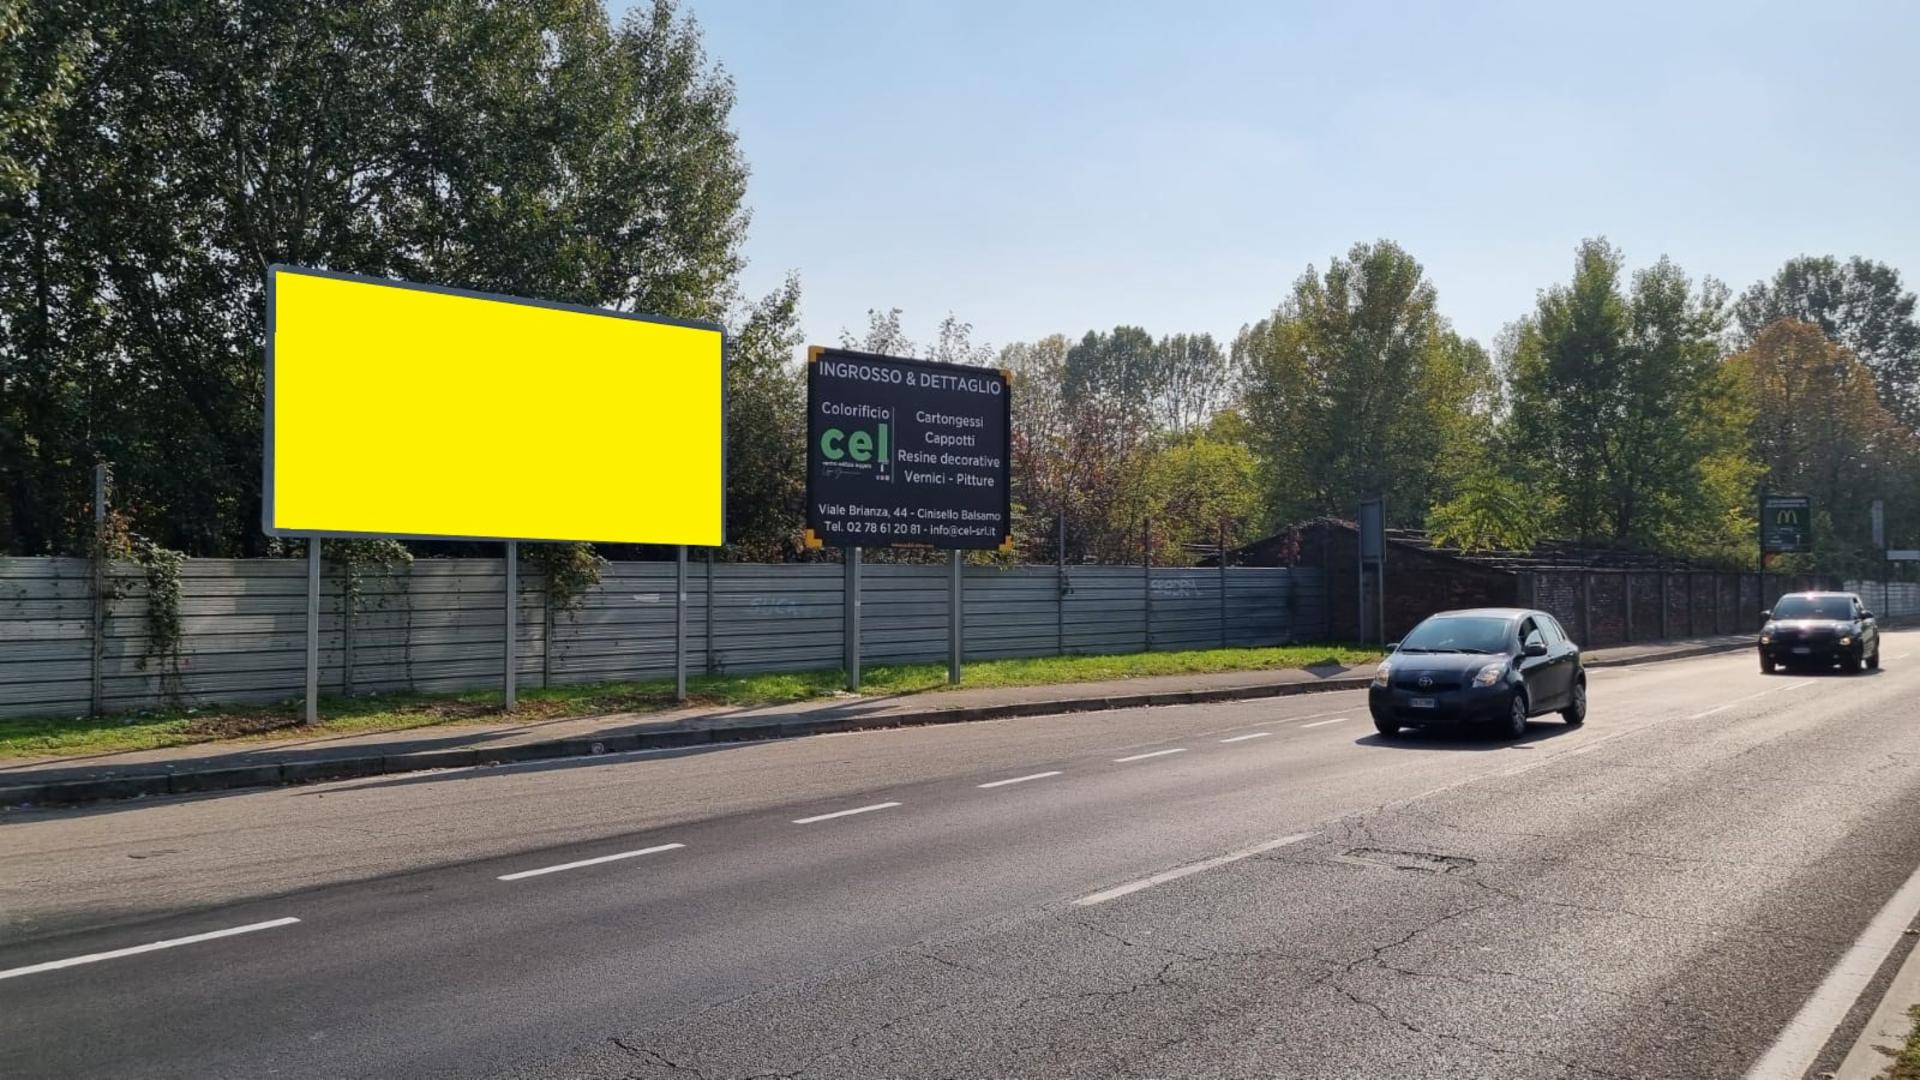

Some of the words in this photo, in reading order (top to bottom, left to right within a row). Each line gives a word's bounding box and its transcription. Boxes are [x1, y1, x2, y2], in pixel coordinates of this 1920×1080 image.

[819, 361, 902, 384] INGROSSO
[906, 371, 916, 386] &
[920, 373, 1001, 395] DETTAGLIO
[821, 401, 890, 420] Colorificio
[916, 410, 984, 429] Cartongessi
[820, 423, 889, 463] cel
[925, 431, 976, 447] Cappotti
[898, 449, 937, 464] Resine
[940, 452, 1001, 468] decorative
[904, 470, 946, 485] Vernici
[956, 472, 995, 487] Pitture
[818, 503, 846, 516] Viale
[849, 505, 891, 518] Brianza,
[893, 507, 908, 518] 44
[917, 508, 959, 520] Cinisello
[961, 509, 1001, 521] Balsamo
[824, 521, 844, 533] Tel.
[846, 521, 862, 533] 02
[864, 522, 877, 533] 78
[880, 522, 891, 534] 61
[894, 523, 908, 534] 20
[910, 523, 921, 535] 81
[930, 524, 997, 537] info@cel-srl.it
